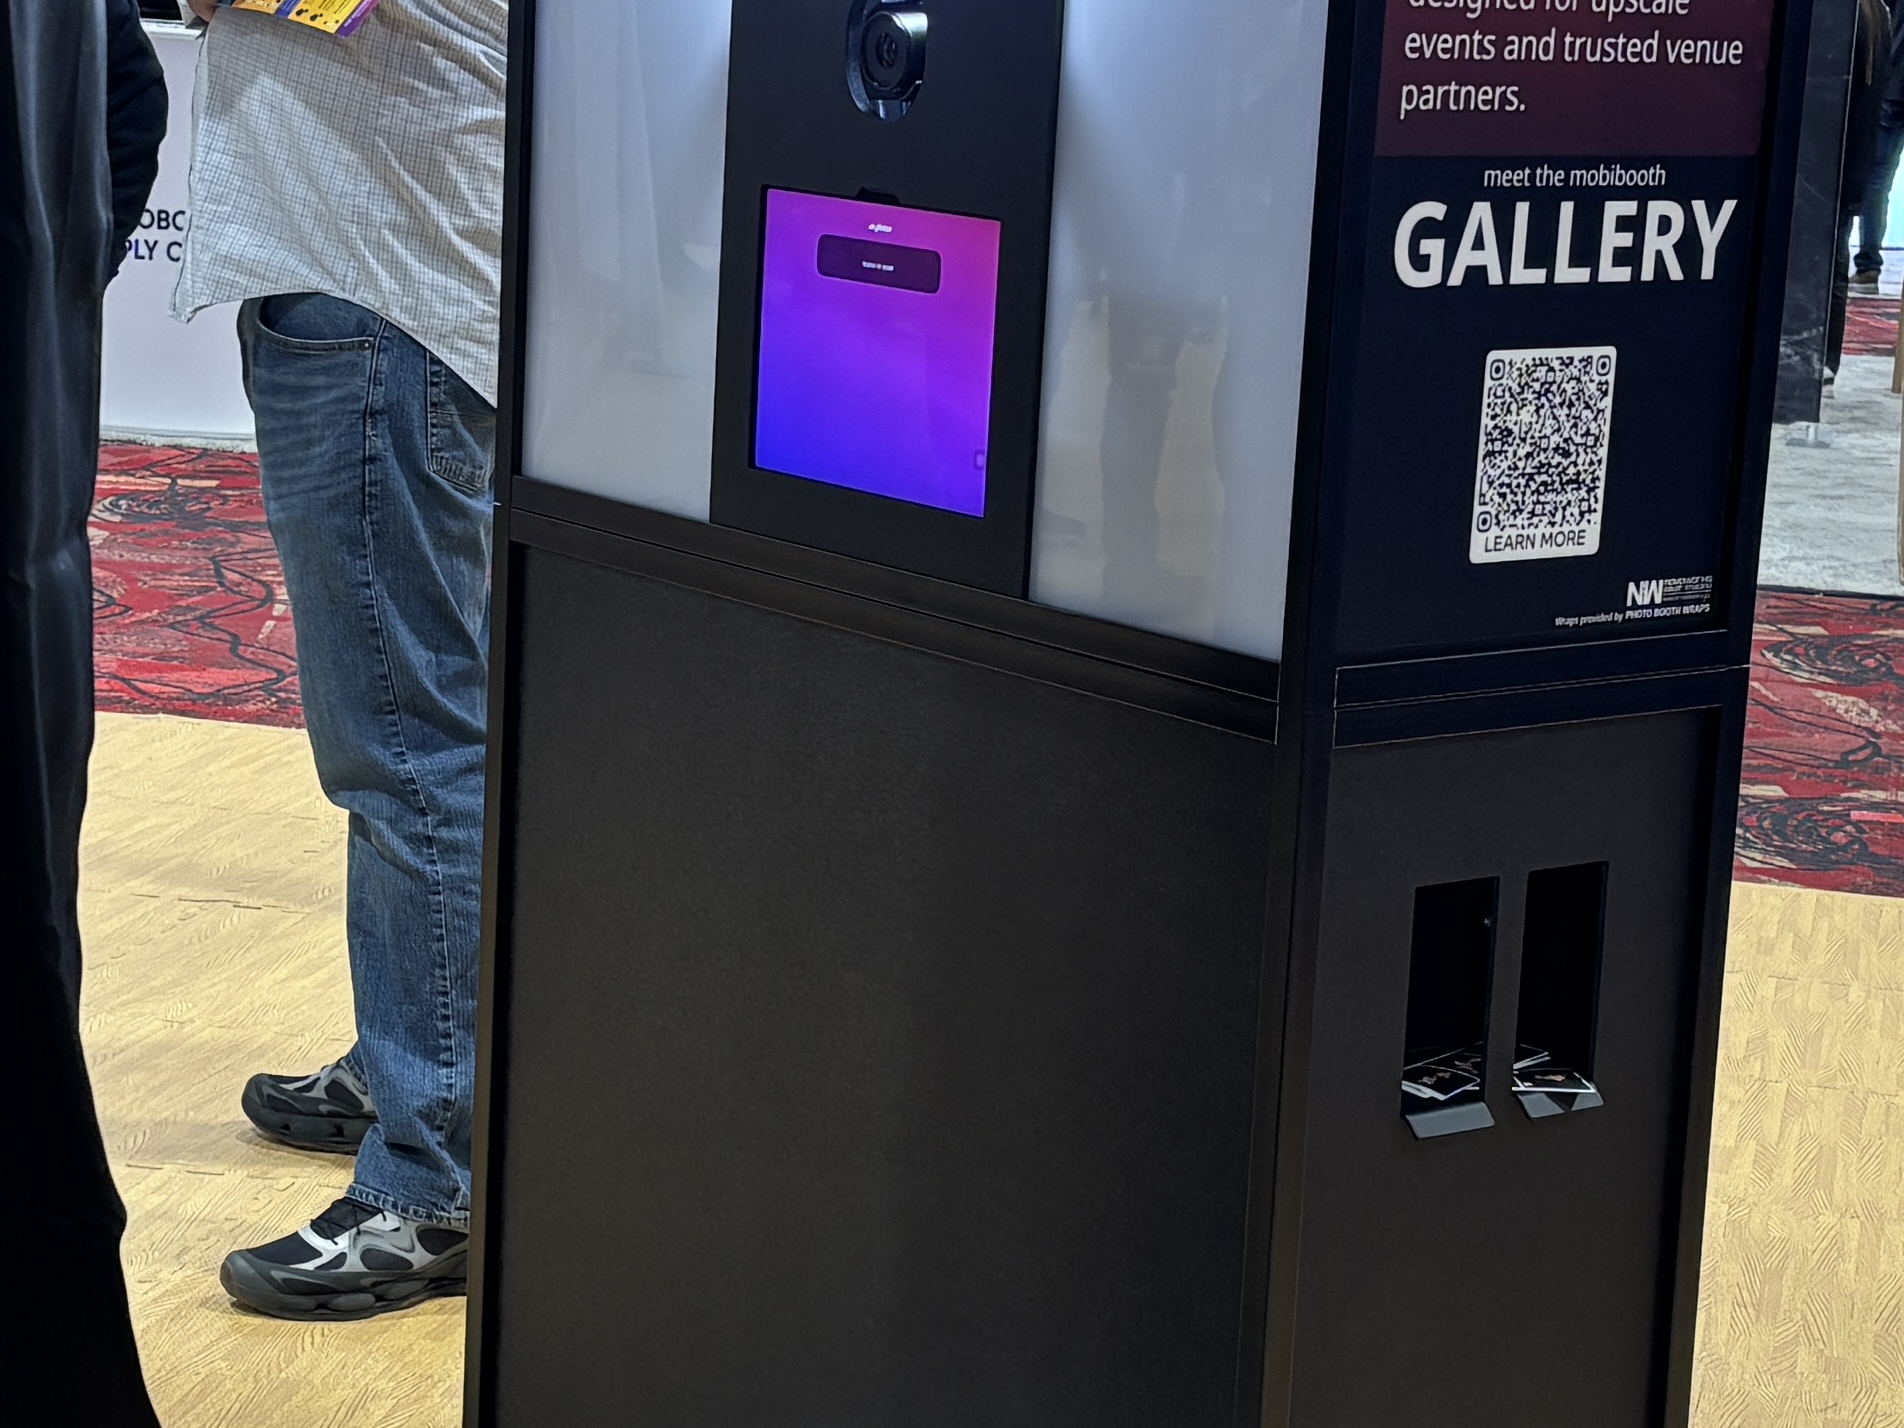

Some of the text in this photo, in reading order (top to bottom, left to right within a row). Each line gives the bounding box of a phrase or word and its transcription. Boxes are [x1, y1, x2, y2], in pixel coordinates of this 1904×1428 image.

[1404, 28, 1743, 65] events and trusted venue
[1399, 80, 1527, 119] partners.
[1484, 165, 1666, 188] meet the mobibooth
[1394, 199, 1738, 288] GALLERY
[1484, 529, 1587, 553] LEARN MORE
[1614, 611, 1623, 623] by
[1625, 607, 1653, 620] PHOTO
[1653, 605, 1682, 617] BOOTH
[1682, 603, 1710, 615] WRAPS
